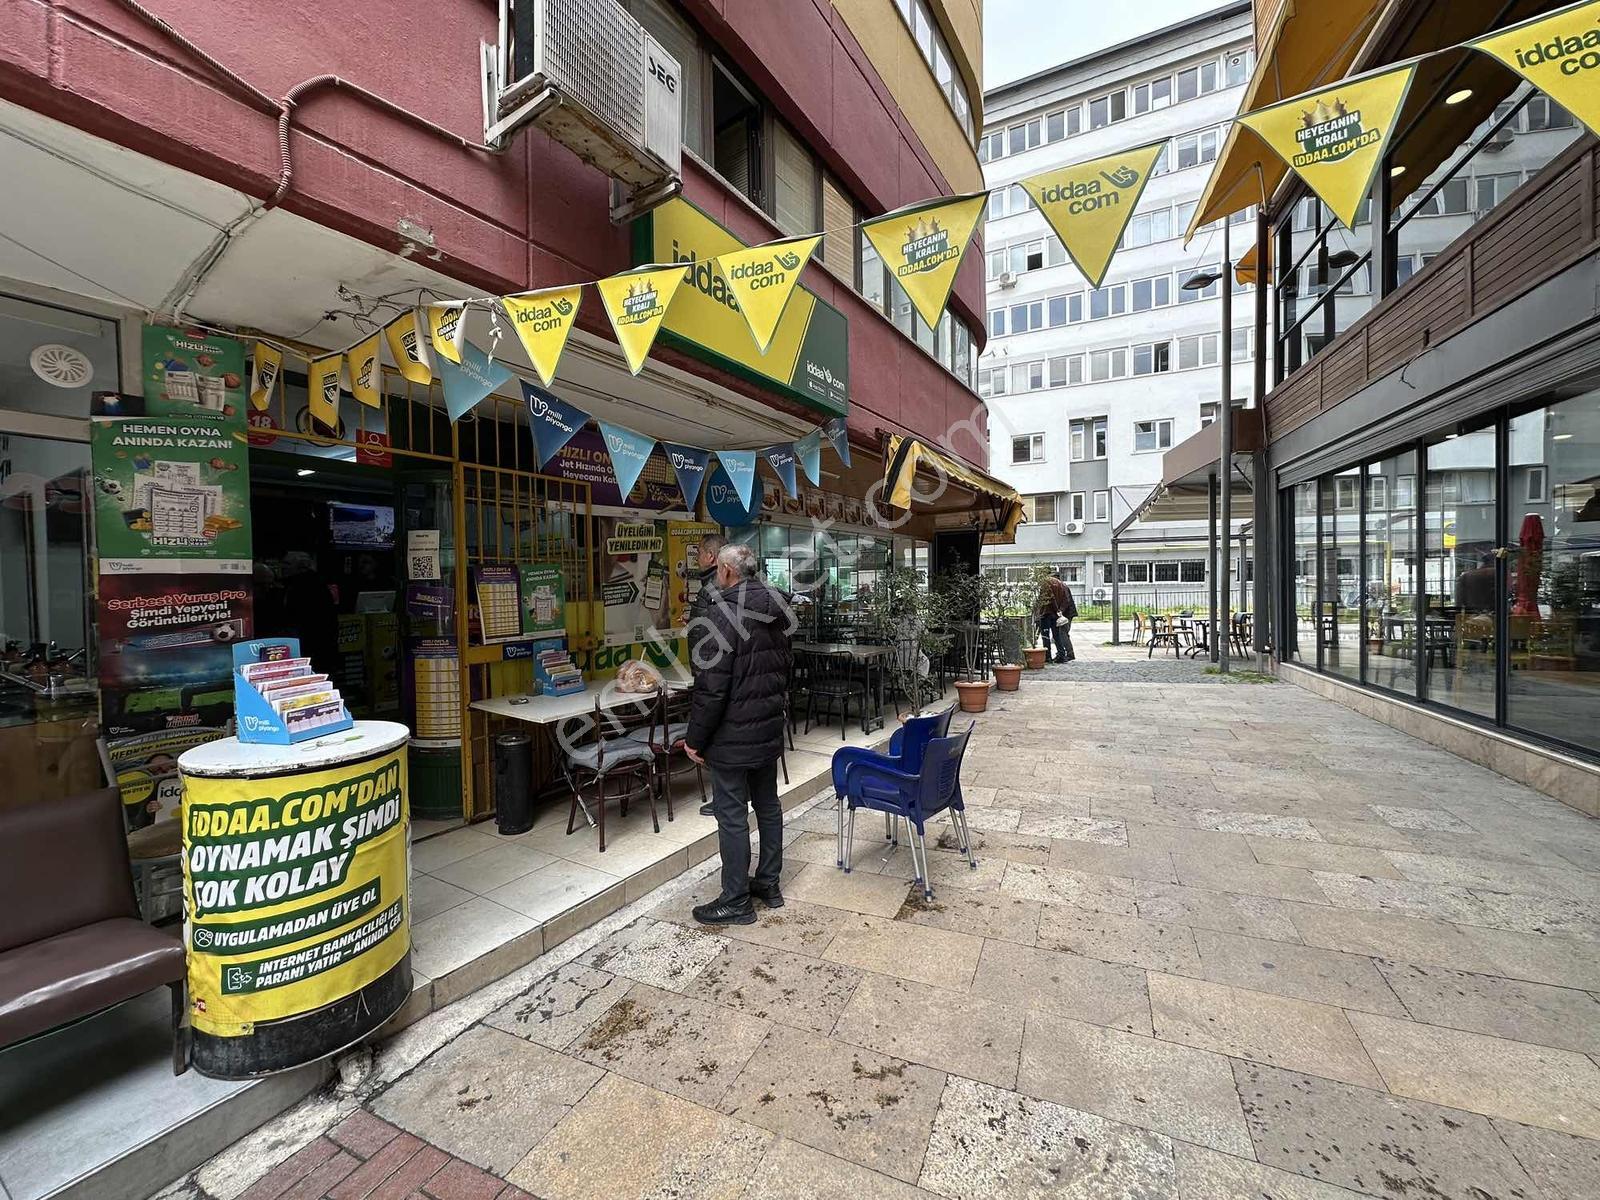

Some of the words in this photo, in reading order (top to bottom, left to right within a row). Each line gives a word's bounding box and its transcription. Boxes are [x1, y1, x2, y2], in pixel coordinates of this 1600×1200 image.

[1298, 113, 1359, 141] HEYECANIN
[1316, 129, 1348, 148] KRALI
[1041, 180, 1101, 205] iddaa
[1069, 191, 1120, 215] com
[903, 231, 948, 254] HEYECANIN
[915, 245, 940, 260] KRALI
[731, 261, 775, 280] iddaa
[750, 272, 785, 290] com
[623, 291, 658, 308] HEYECANIN
[631, 302, 651, 313] KRALI
[516, 307, 552, 324] iddaa
[533, 317, 562, 333] com
[460, 366, 494, 388] piyango
[806, 360, 826, 380] iddaa
[832, 378, 846, 392] com
[547, 408, 563, 421] milli
[122, 424, 178, 436] HEMEN
[180, 426, 222, 437] OYNA
[545, 416, 573, 433] piyango
[112, 436, 175, 448] ANINDA
[177, 439, 233, 449] KAZAN!
[560, 459, 575, 469] Jet
[152, 536, 189, 546] HIZLI
[108, 595, 173, 611] Serbest
[174, 591, 219, 606] Vuruş
[220, 590, 247, 601] Pro
[131, 603, 172, 619] Şimdi
[175, 600, 228, 615] Yepyeni
[126, 610, 232, 629] Görüntüleriyle!
[190, 821, 337, 873] OYNAMAK
[244, 852, 350, 905] KOLAY
[214, 909, 328, 947] UYGULAMADAN
[331, 897, 359, 921] ÜYE
[361, 890, 377, 906] OL
[322, 911, 388, 953] BANKACILIĞI
[255, 968, 306, 988] PARANI
[306, 954, 342, 976] YATIR
[353, 924, 389, 954] ANINDA
